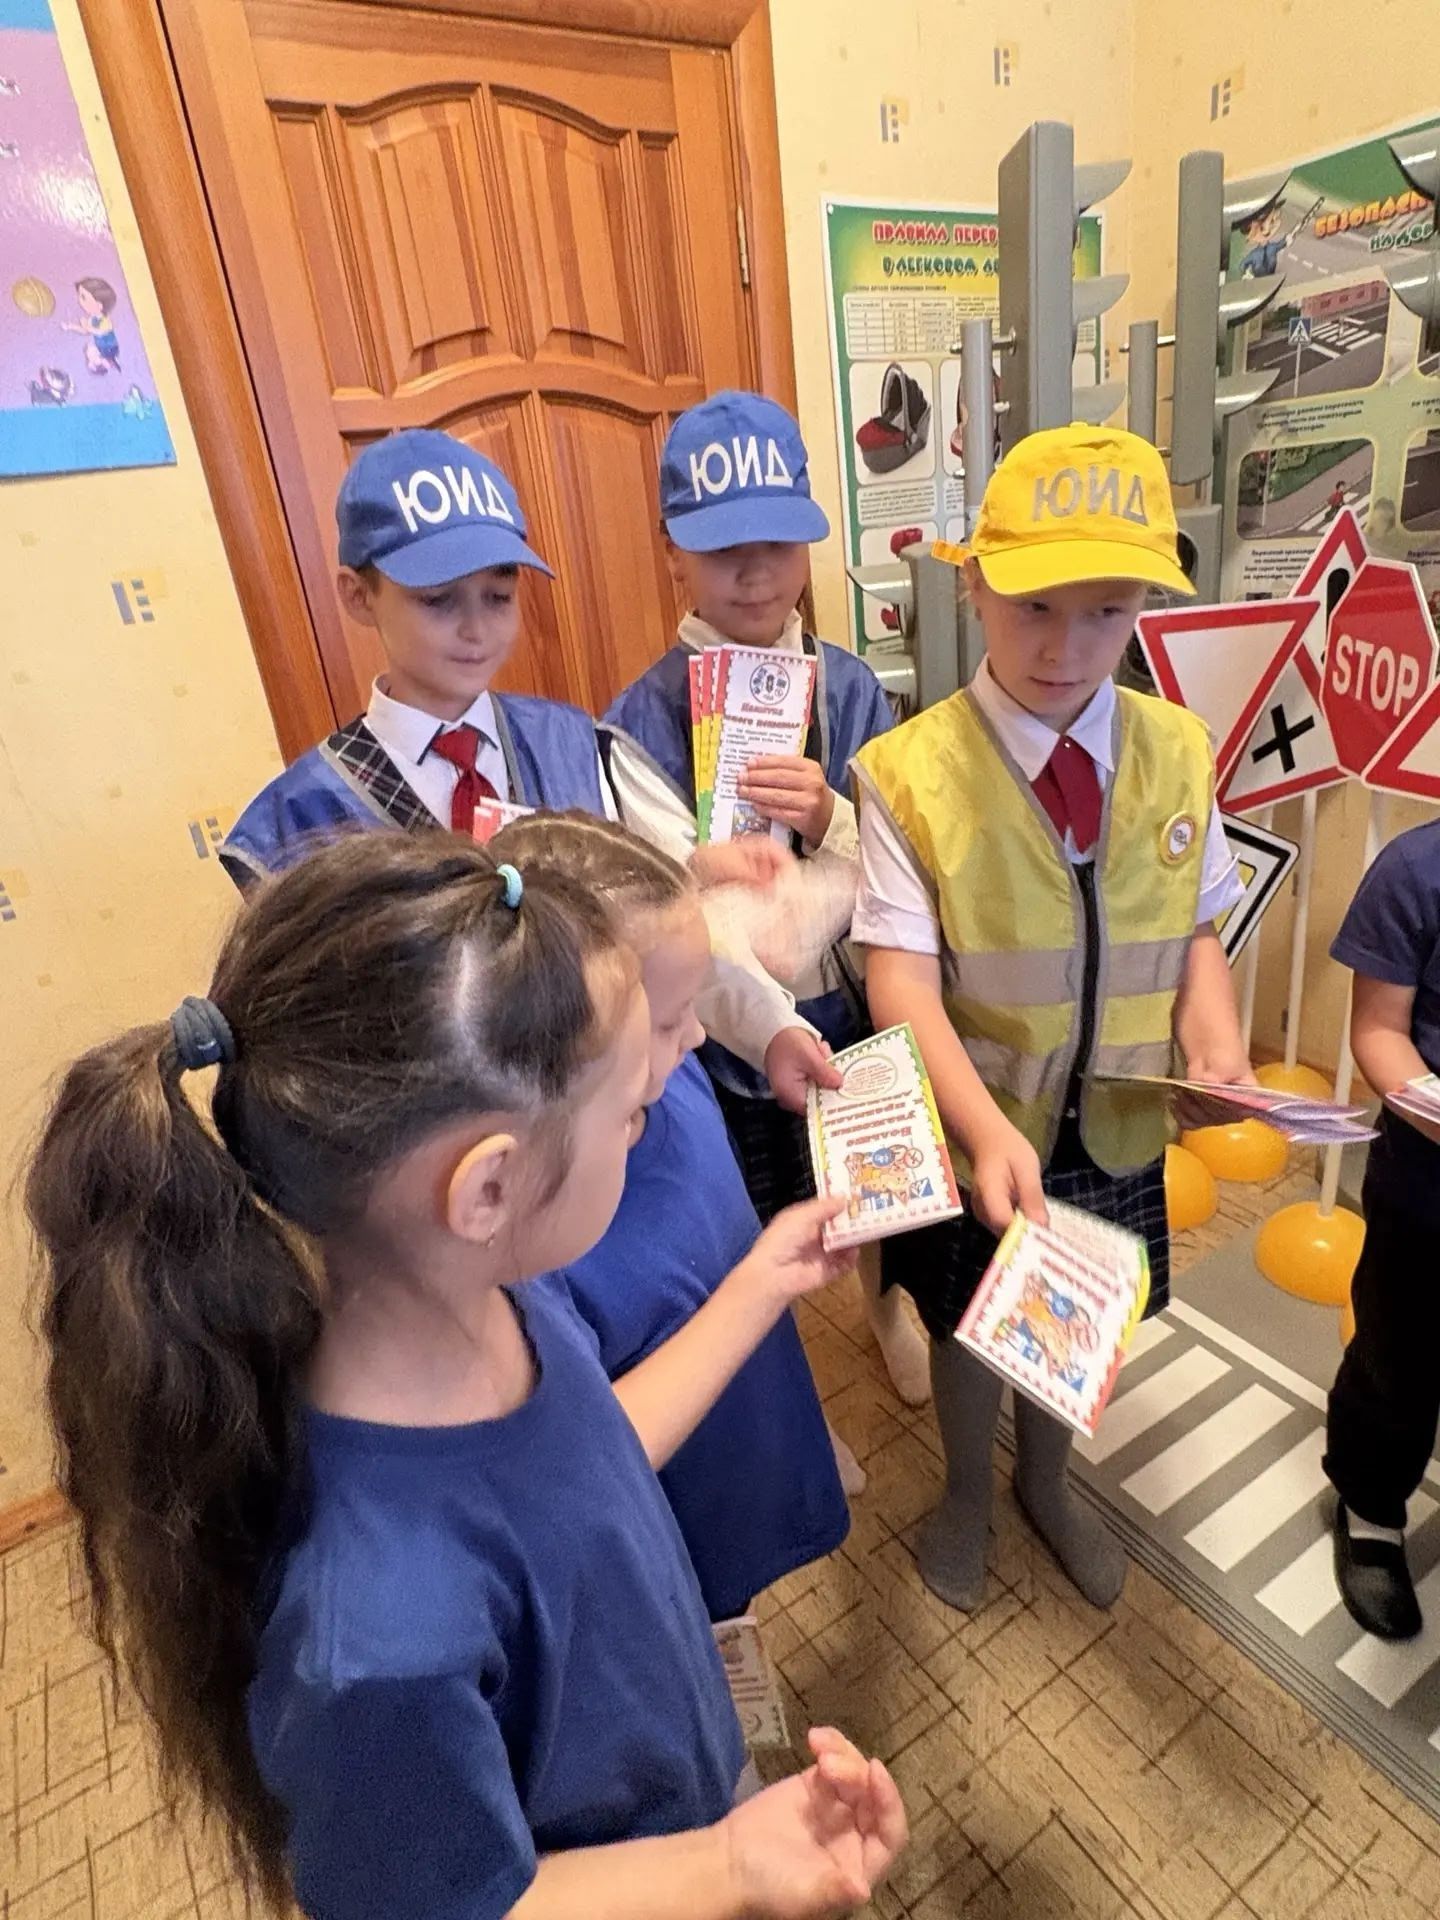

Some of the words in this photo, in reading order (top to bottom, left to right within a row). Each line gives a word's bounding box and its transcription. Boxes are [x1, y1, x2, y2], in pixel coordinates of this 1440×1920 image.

[873, 220, 948, 245] ПРАВИЛА
[953, 223, 999, 247] ПЕРЕВ
[1315, 191, 1429, 239] БЕЗОПАСН
[392, 465, 515, 533] ЮИД
[689, 436, 793, 501] ЮИД
[1031, 464, 1148, 526] ЮИД
[1332, 634, 1419, 717] STOP
